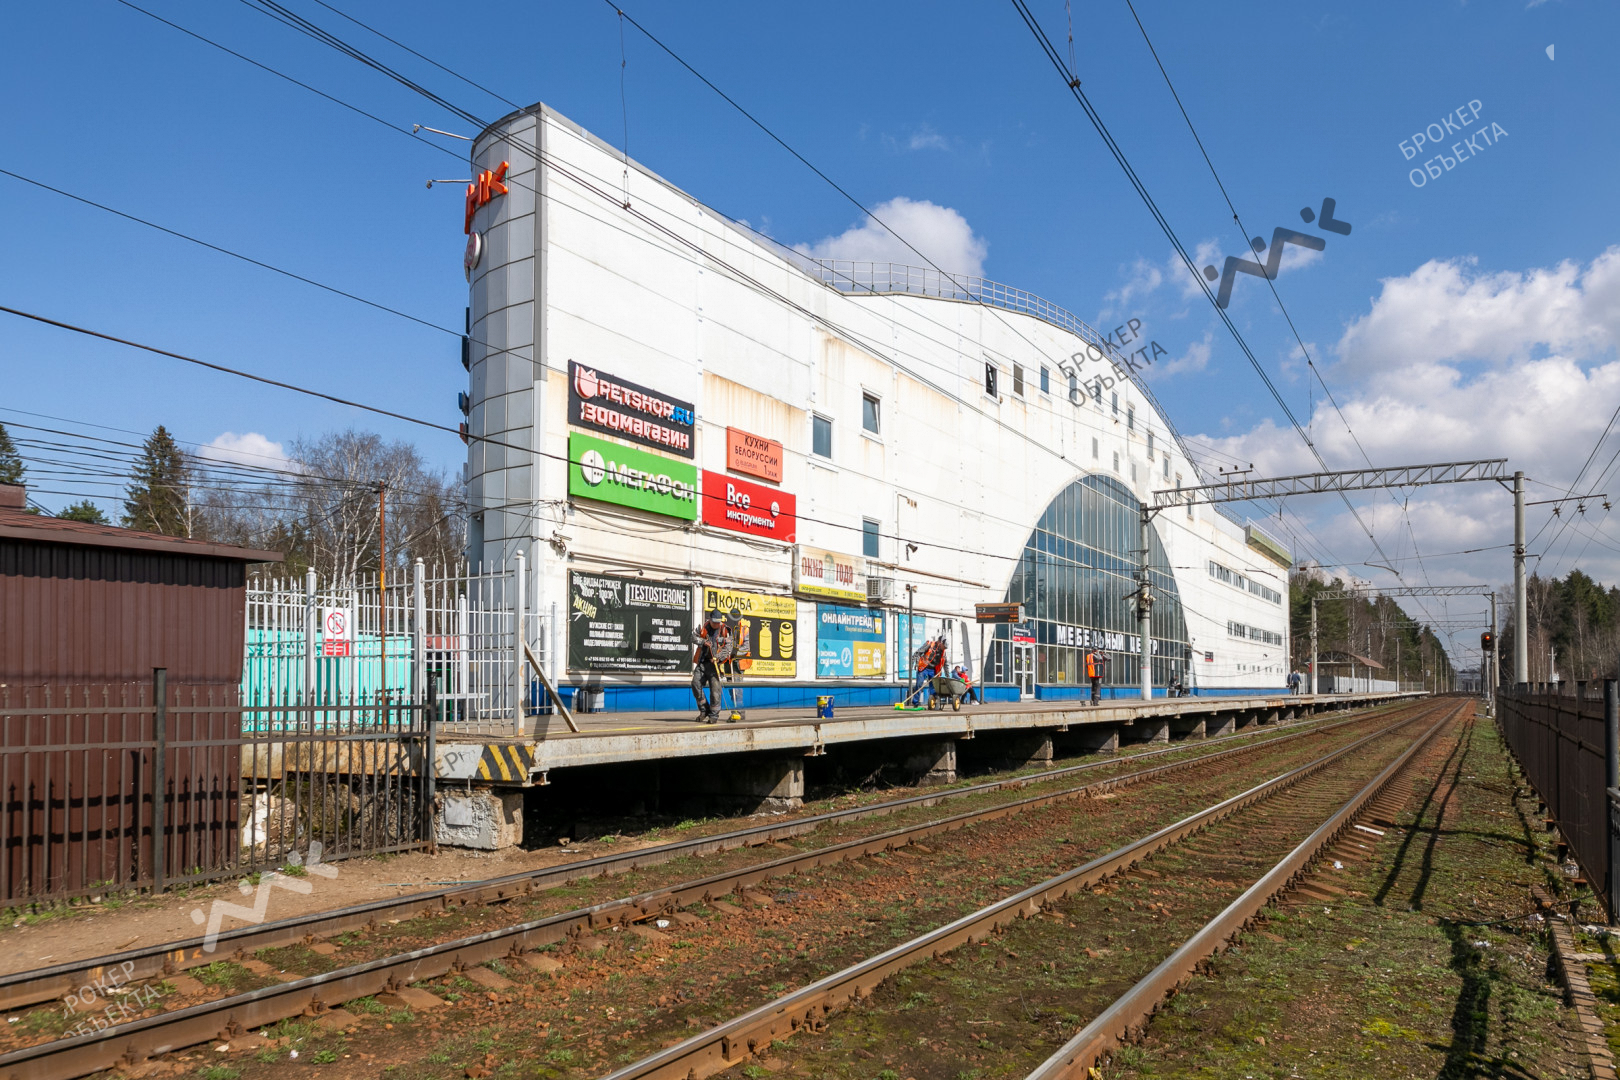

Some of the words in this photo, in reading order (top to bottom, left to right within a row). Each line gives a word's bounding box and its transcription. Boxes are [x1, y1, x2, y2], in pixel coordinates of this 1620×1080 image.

[744, 434, 769, 452] КУХНИ
[735, 445, 778, 467] БЕЛОРУССИИ
[726, 483, 751, 509] Все
[726, 510, 775, 529] инструменты
[801, 556, 824, 579] окна
[835, 562, 854, 586] года
[630, 584, 686, 605] TESTOSTERONE
[719, 594, 752, 611] КОЛБА
[573, 594, 597, 619] АКЦИЯ
[822, 612, 873, 629] ОНЛАЙНТРЕЙД
[1056, 624, 1124, 651] МЕБЕЛЬНЫЙ
[1130, 636, 1158, 655] ЦЕР
